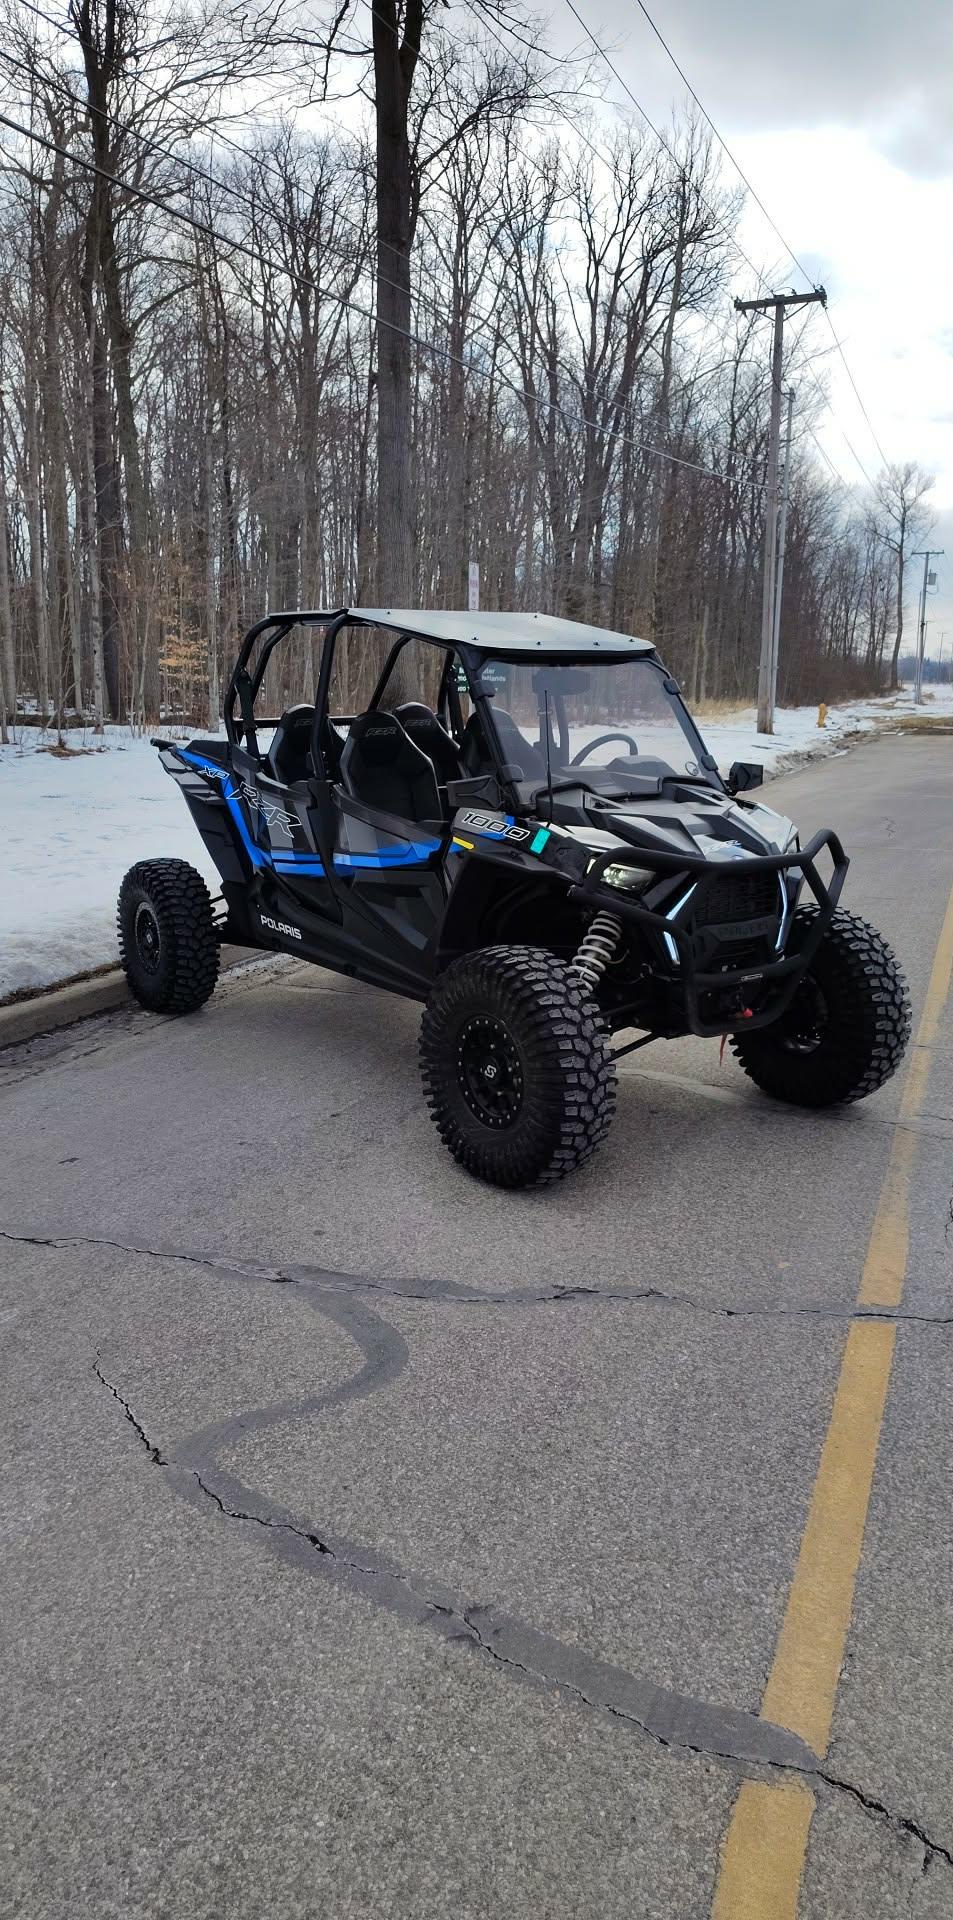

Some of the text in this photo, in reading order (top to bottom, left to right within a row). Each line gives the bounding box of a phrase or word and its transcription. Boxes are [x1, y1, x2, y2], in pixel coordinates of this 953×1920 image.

[202, 765, 230, 779] XP
[226, 781, 302, 839] RZR
[462, 811, 531, 841] 1000
[260, 914, 303, 940] POLARIS
